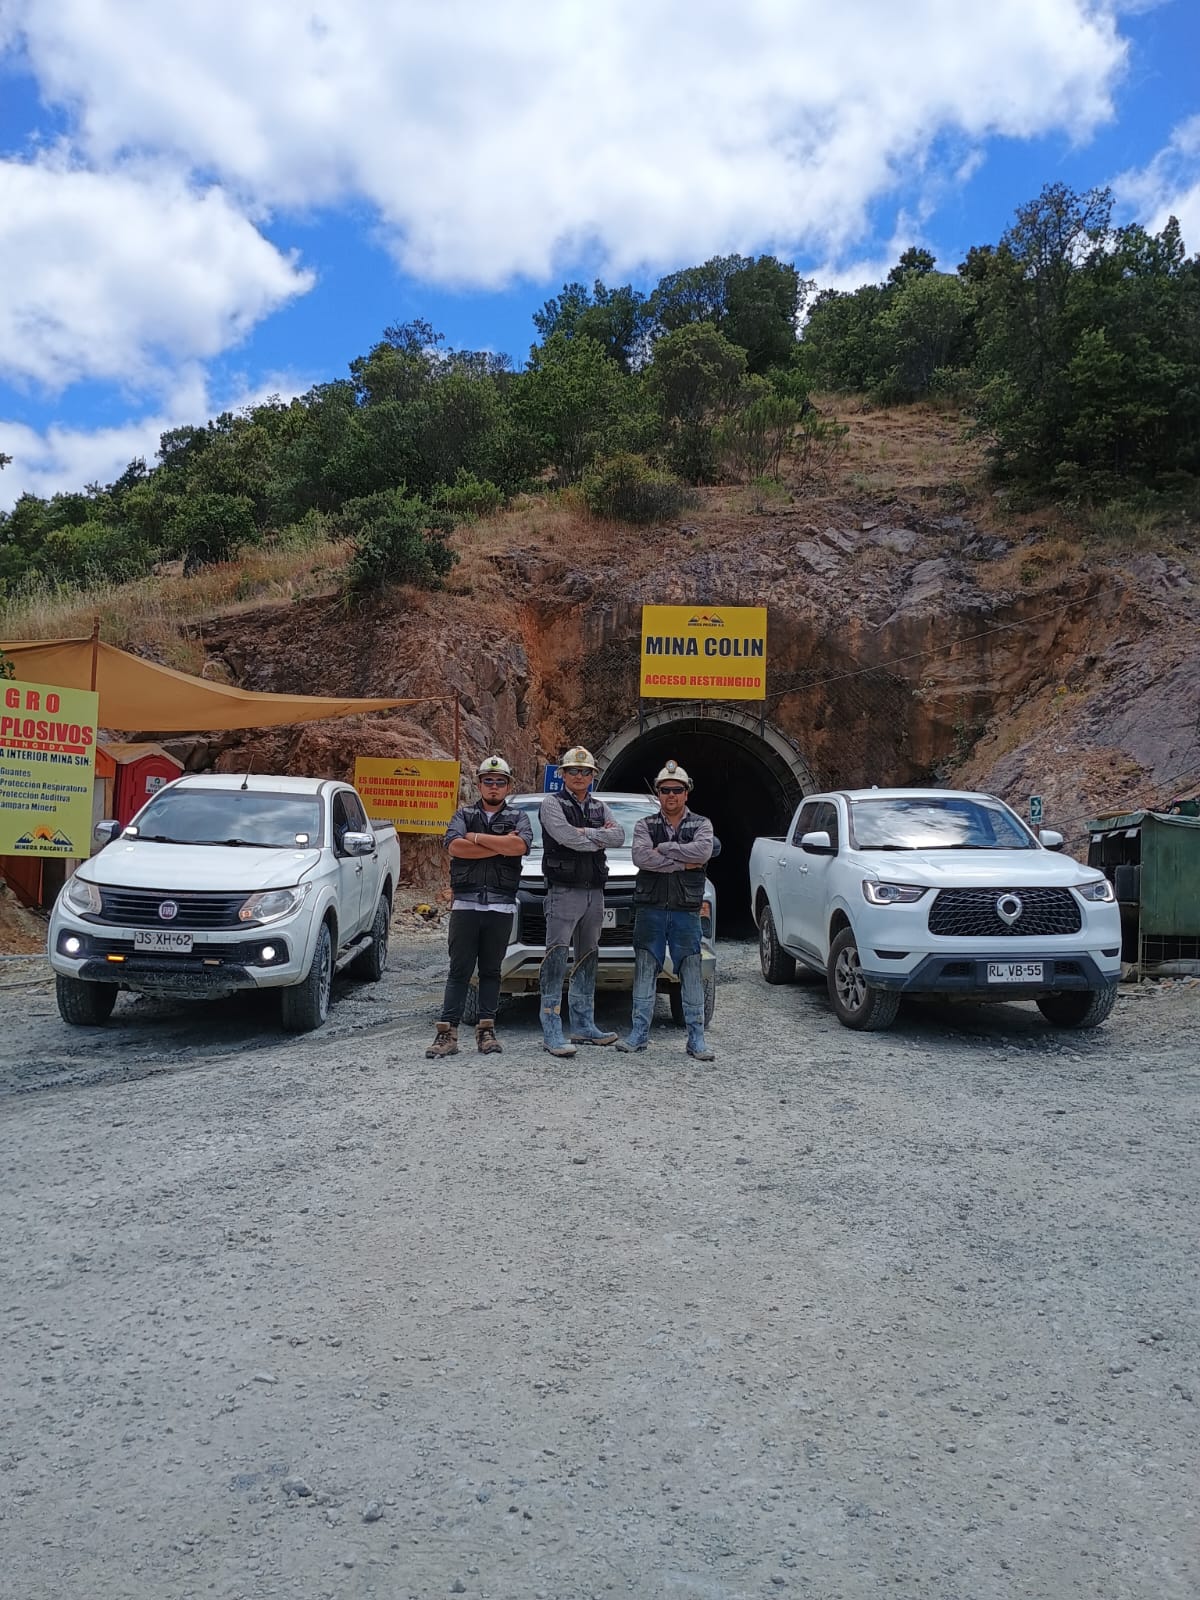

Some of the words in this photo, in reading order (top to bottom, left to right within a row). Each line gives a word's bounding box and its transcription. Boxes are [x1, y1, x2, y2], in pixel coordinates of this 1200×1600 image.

[645, 637, 698, 655] MINA
[704, 637, 763, 657] COLIN
[645, 675, 687, 686] ACCESO
[690, 676, 761, 688] RESTRINGIDO
[0, 716, 93, 746] PLOSIVOS
[7, 749, 48, 762] INTERIOR
[50, 753, 73, 765] MINA
[0, 767, 31, 777] Guantes
[42, 782, 87, 793] Respiratoria
[358, 776, 367, 785] ES
[368, 776, 416, 787] OBLIGATORIO
[417, 779, 455, 789] INFORMAR
[40, 793, 70, 803] Auditiva
[358, 787, 363, 795] Y
[364, 787, 404, 797] REGISTRAR
[405, 790, 415, 798] SU
[416, 790, 449, 799] INGRESO
[450, 791, 454, 799] Y
[0, 801, 30, 810] ampara
[31, 803, 57, 812] Minera
[372, 798, 398, 807] SALIDA
[399, 800, 408, 808] DE
[419, 801, 439, 809] MINA
